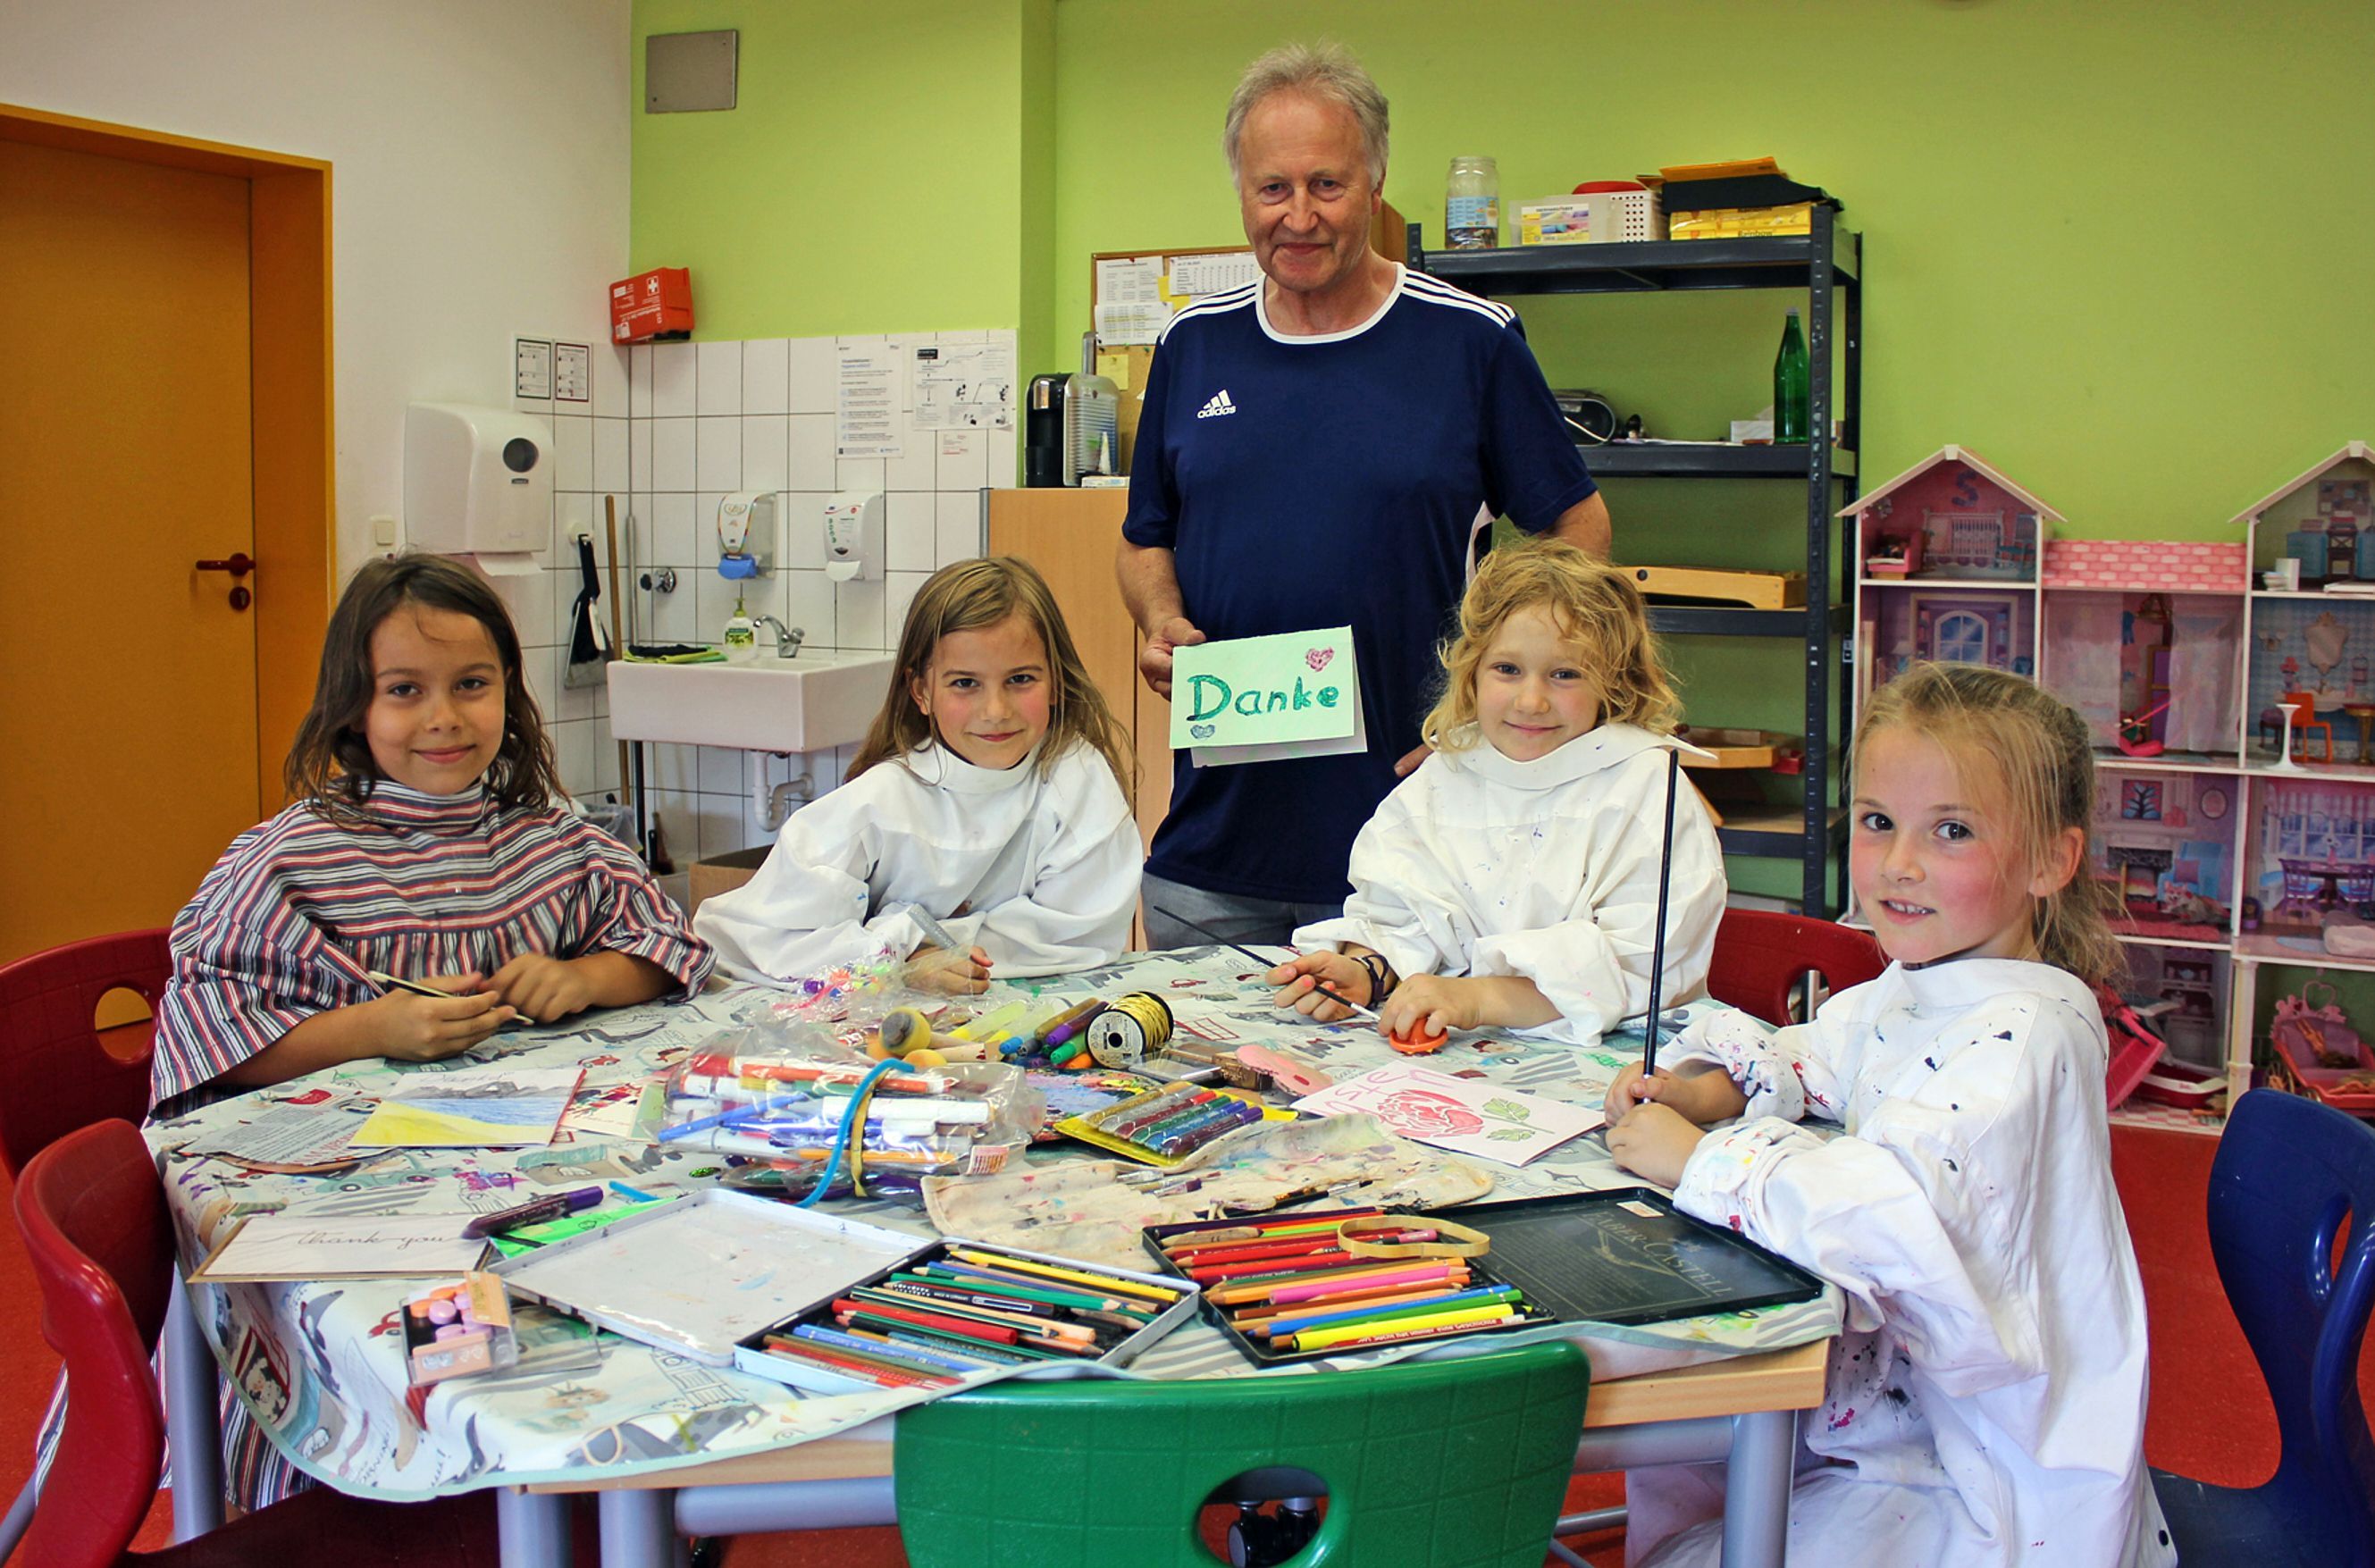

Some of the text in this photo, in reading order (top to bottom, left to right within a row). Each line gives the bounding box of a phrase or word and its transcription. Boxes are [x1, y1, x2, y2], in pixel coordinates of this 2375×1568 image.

[1197, 406, 1237, 419] adidas
[1186, 675, 1339, 721] Danke
[397, 1237, 443, 1250] you
